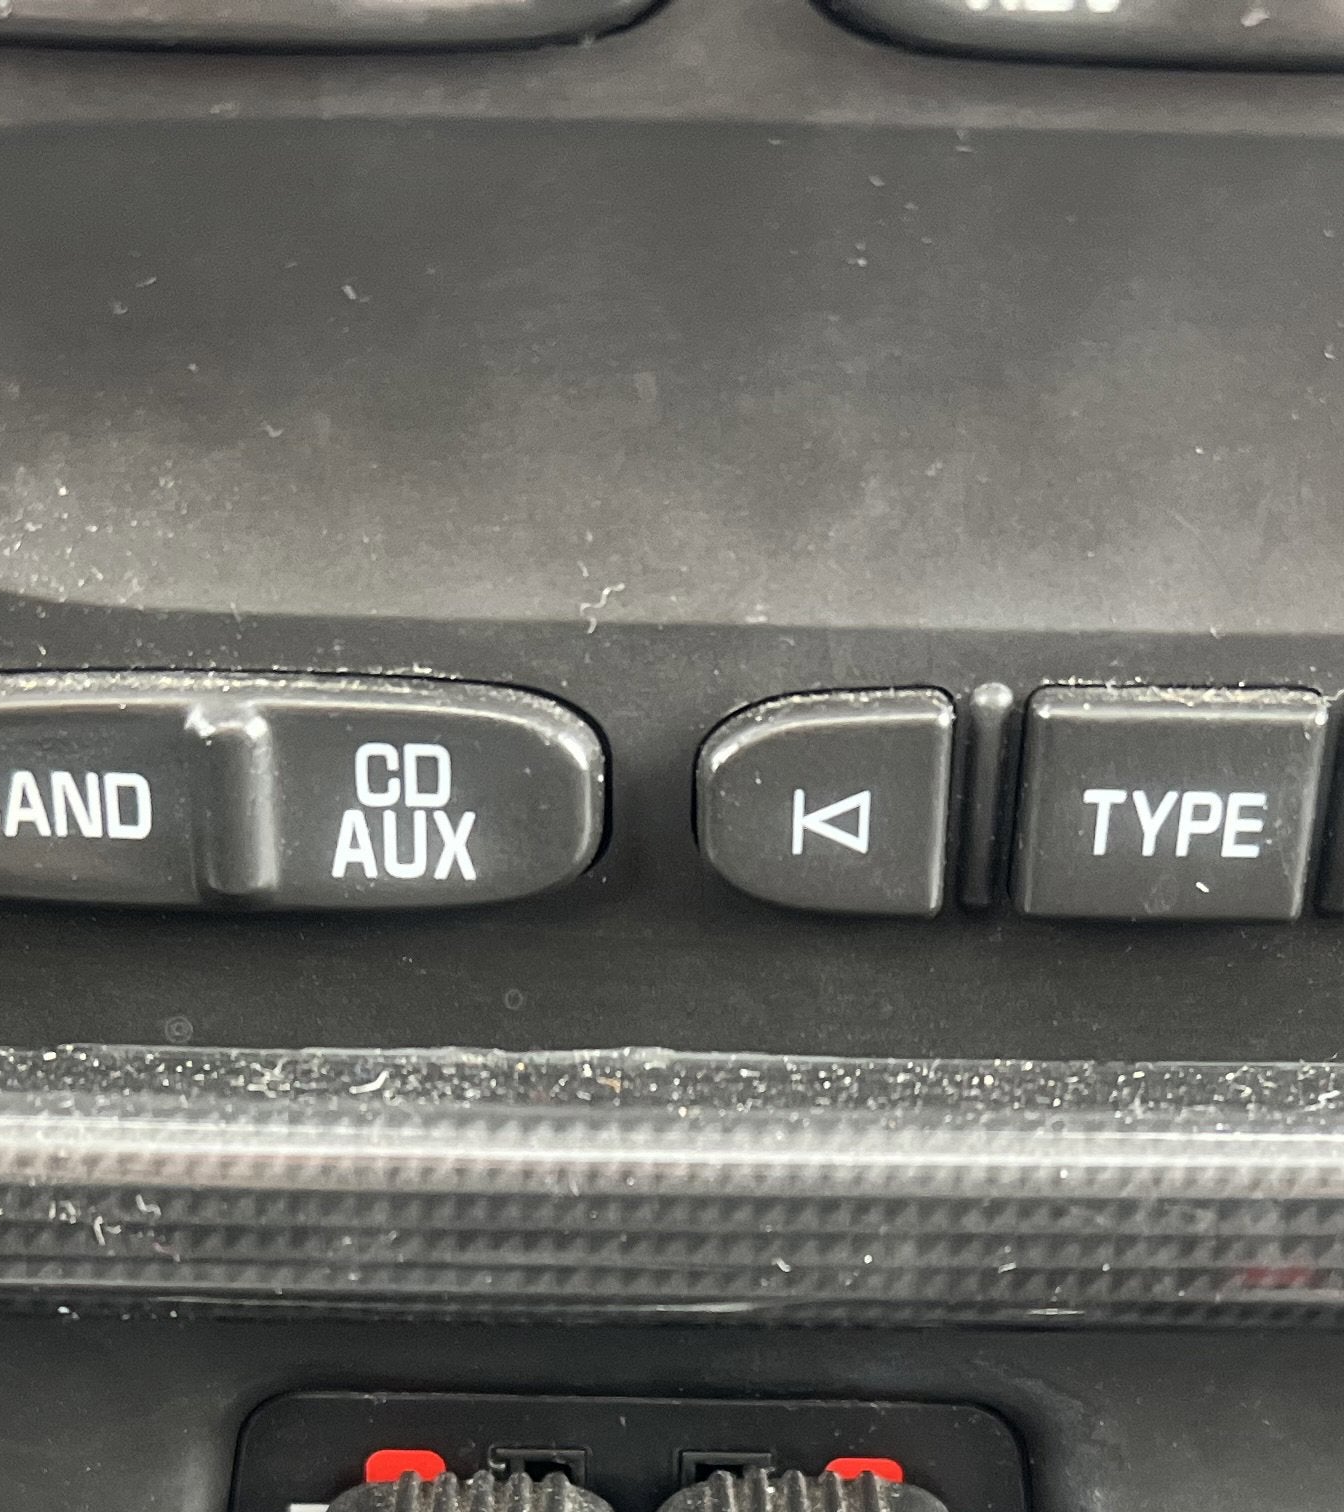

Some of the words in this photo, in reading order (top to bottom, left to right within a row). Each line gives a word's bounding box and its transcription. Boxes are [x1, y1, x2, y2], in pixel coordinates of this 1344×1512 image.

[354, 742, 453, 808] CD
[331, 810, 478, 882] AUX
[1082, 788, 1268, 858] TYPE
